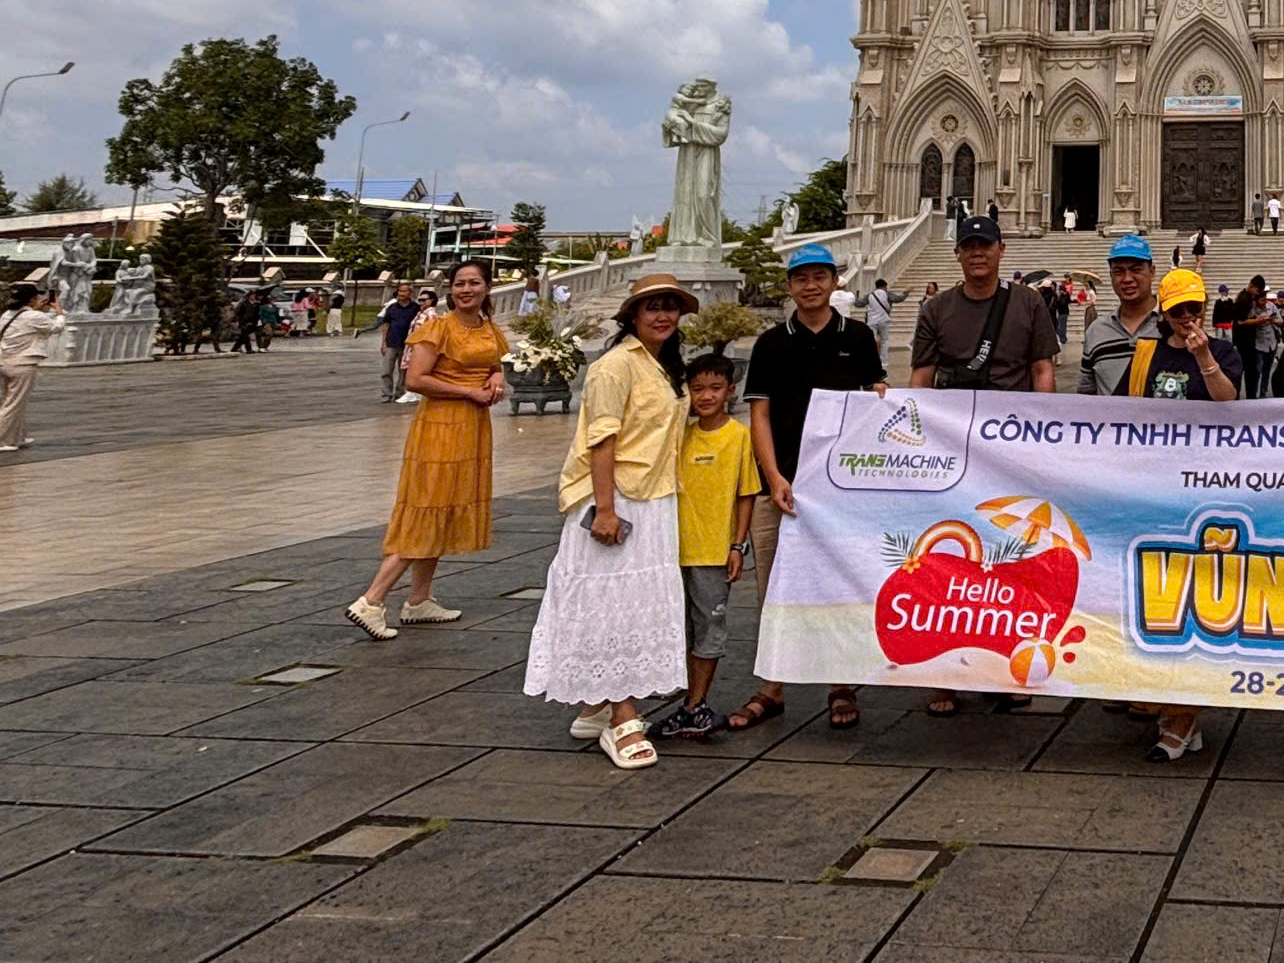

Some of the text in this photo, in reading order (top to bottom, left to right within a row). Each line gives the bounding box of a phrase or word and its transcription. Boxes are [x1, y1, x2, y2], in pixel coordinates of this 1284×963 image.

[980, 414, 1064, 444] CÔNG
[1070, 421, 1105, 445] TY
[1110, 422, 1192, 447] TNHH
[858, 468, 949, 478] TECHNOLOGIES
[1181, 470, 1241, 489] THAM
[946, 576, 1015, 605] Hello
[887, 593, 1057, 639] Summer
